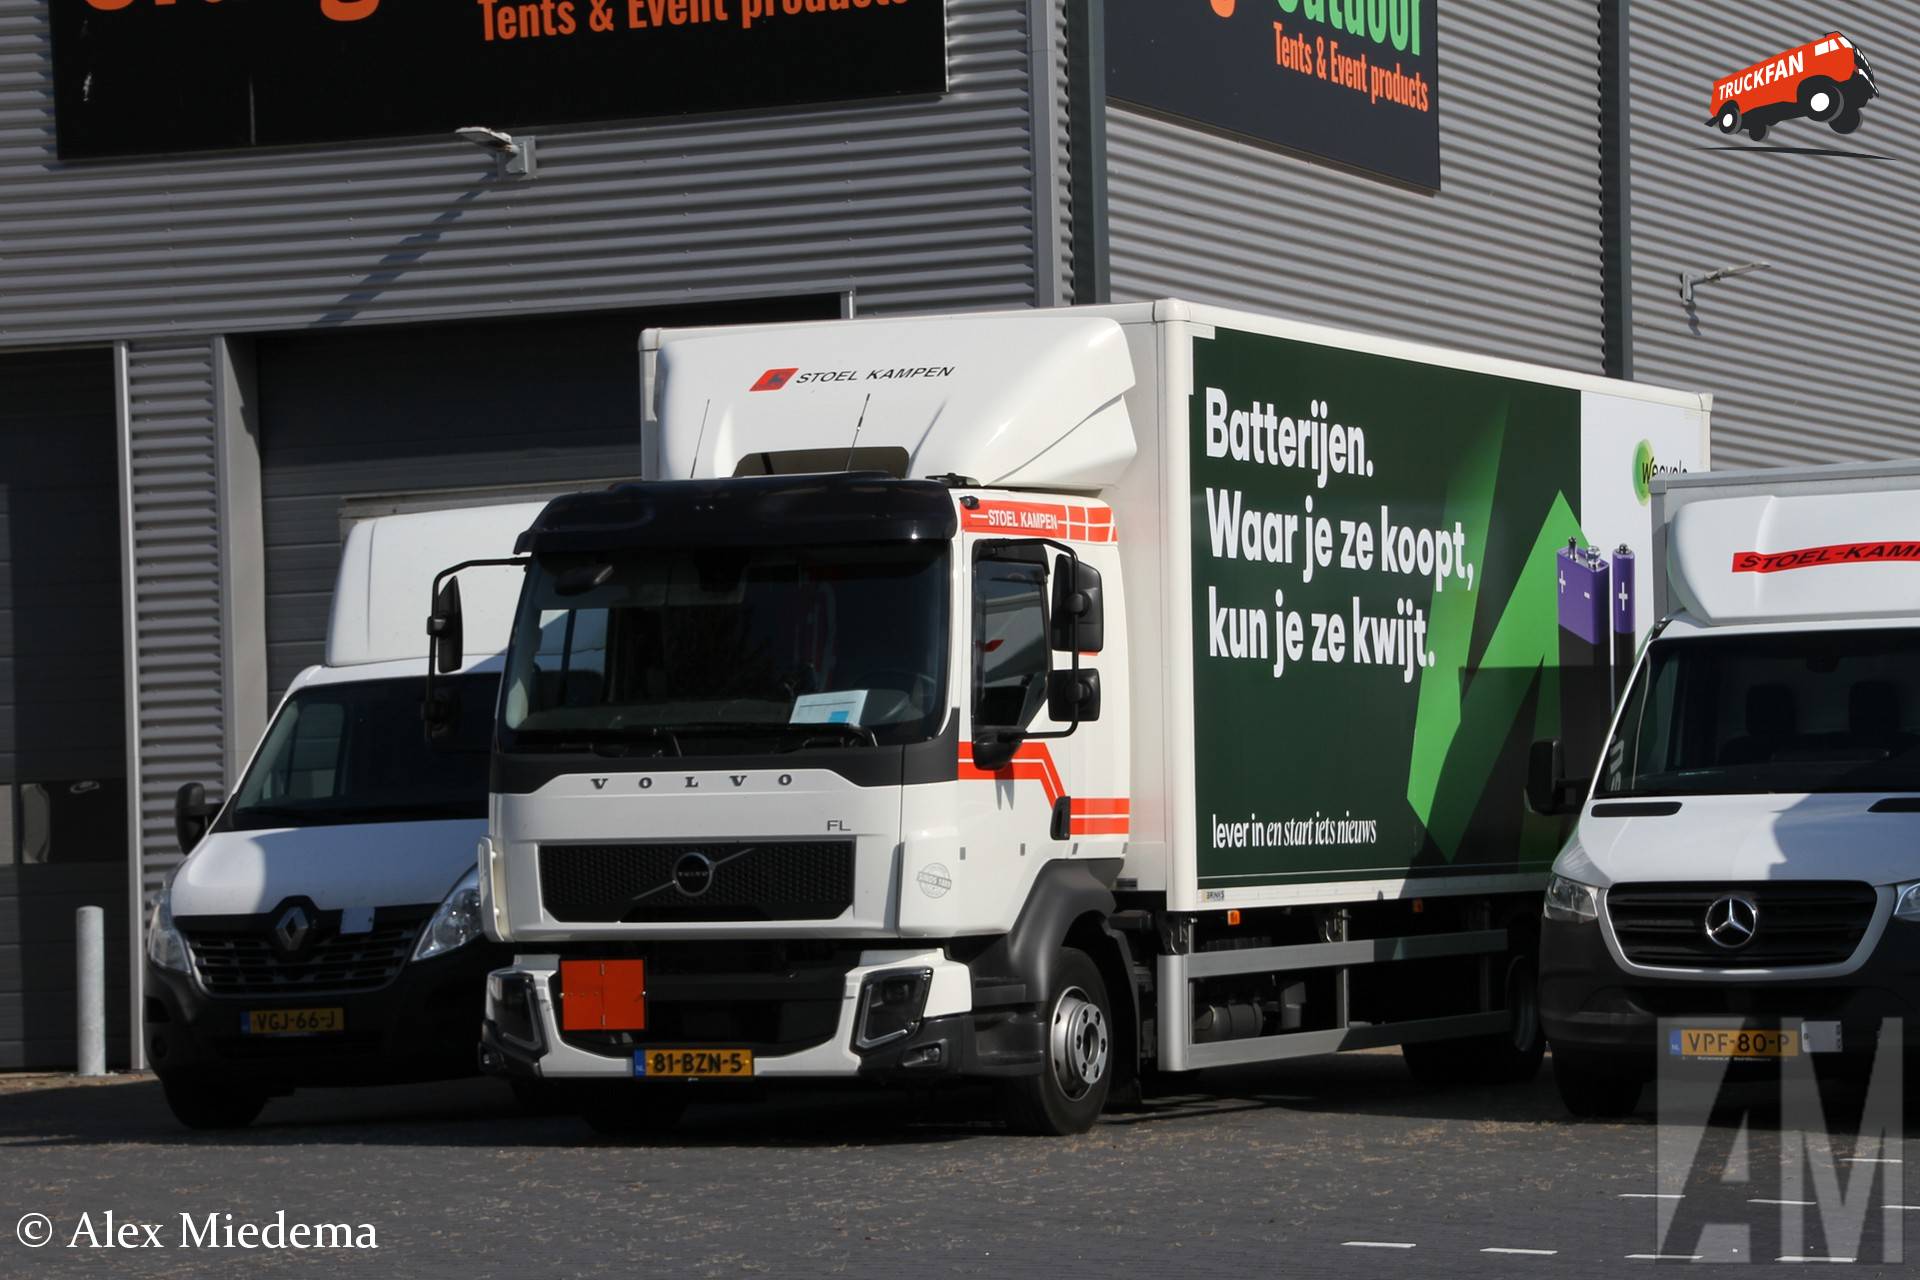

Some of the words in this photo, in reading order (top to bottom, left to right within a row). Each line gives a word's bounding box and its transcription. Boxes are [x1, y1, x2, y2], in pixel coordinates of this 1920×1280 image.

[478, 0, 575, 41] Tents
[588, 0, 613, 32] &
[628, 0, 728, 29] Event
[1273, 21, 1313, 76] Tents
[1316, 36, 1327, 80] &
[1330, 41, 1368, 93] Event
[1371, 63, 1428, 112] products
[796, 370, 859, 384] STOEL
[866, 366, 956, 381] KAMPEN
[1206, 387, 1374, 489] Batterijen.
[988, 509, 1019, 526] STOEL
[1020, 512, 1058, 530] KAMPEN
[1206, 487, 1298, 563] Waar
[1303, 495, 1333, 583] je
[1340, 520, 1374, 571] ze
[1381, 505, 1474, 592] koopt,
[1208, 586, 1268, 659] kun
[1273, 589, 1304, 678] je
[1311, 613, 1346, 663] ze
[1353, 596, 1436, 683] kwijt.
[591, 774, 793, 790] VOLVO
[826, 820, 851, 832] FL
[1212, 813, 1249, 848] lever
[1251, 813, 1265, 847] in
[1266, 820, 1283, 846] en
[1283, 818, 1316, 846] start
[1316, 812, 1335, 845] iets
[1337, 810, 1377, 845] nieuws
[256, 1010, 335, 1030] VGJ-66-J
[1687, 1033, 1790, 1053] VPF-80-P
[653, 1053, 743, 1074] 81-BZN-5
